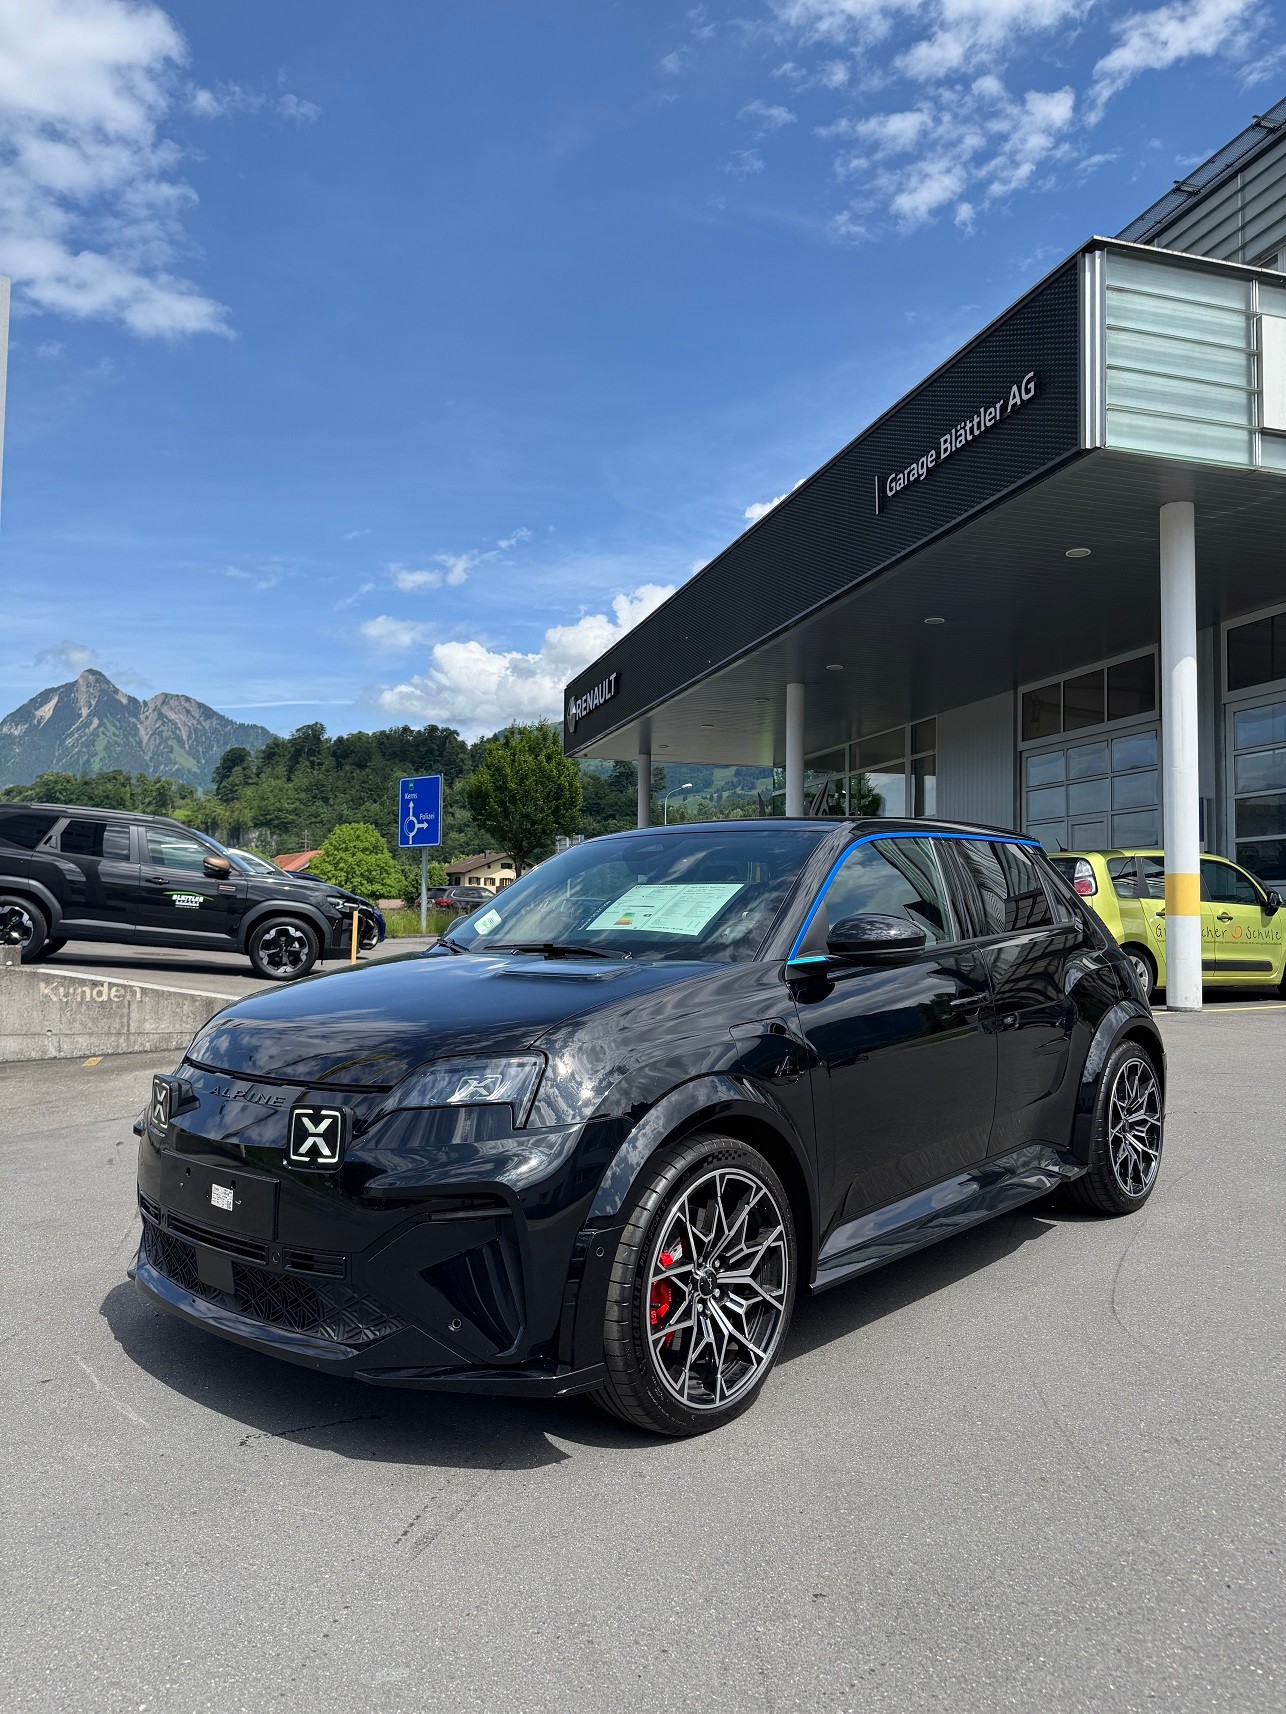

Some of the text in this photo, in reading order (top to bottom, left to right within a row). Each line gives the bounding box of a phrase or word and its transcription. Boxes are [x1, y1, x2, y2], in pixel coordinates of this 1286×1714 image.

[886, 371, 1035, 497] Garage Blättler AG
[576, 671, 617, 720] RENAULT
[419, 812, 436, 820] Polizei
[1245, 926, 1282, 941] Schule
[40, 981, 142, 1002] Kunden
[209, 1085, 286, 1107] ALPINE
